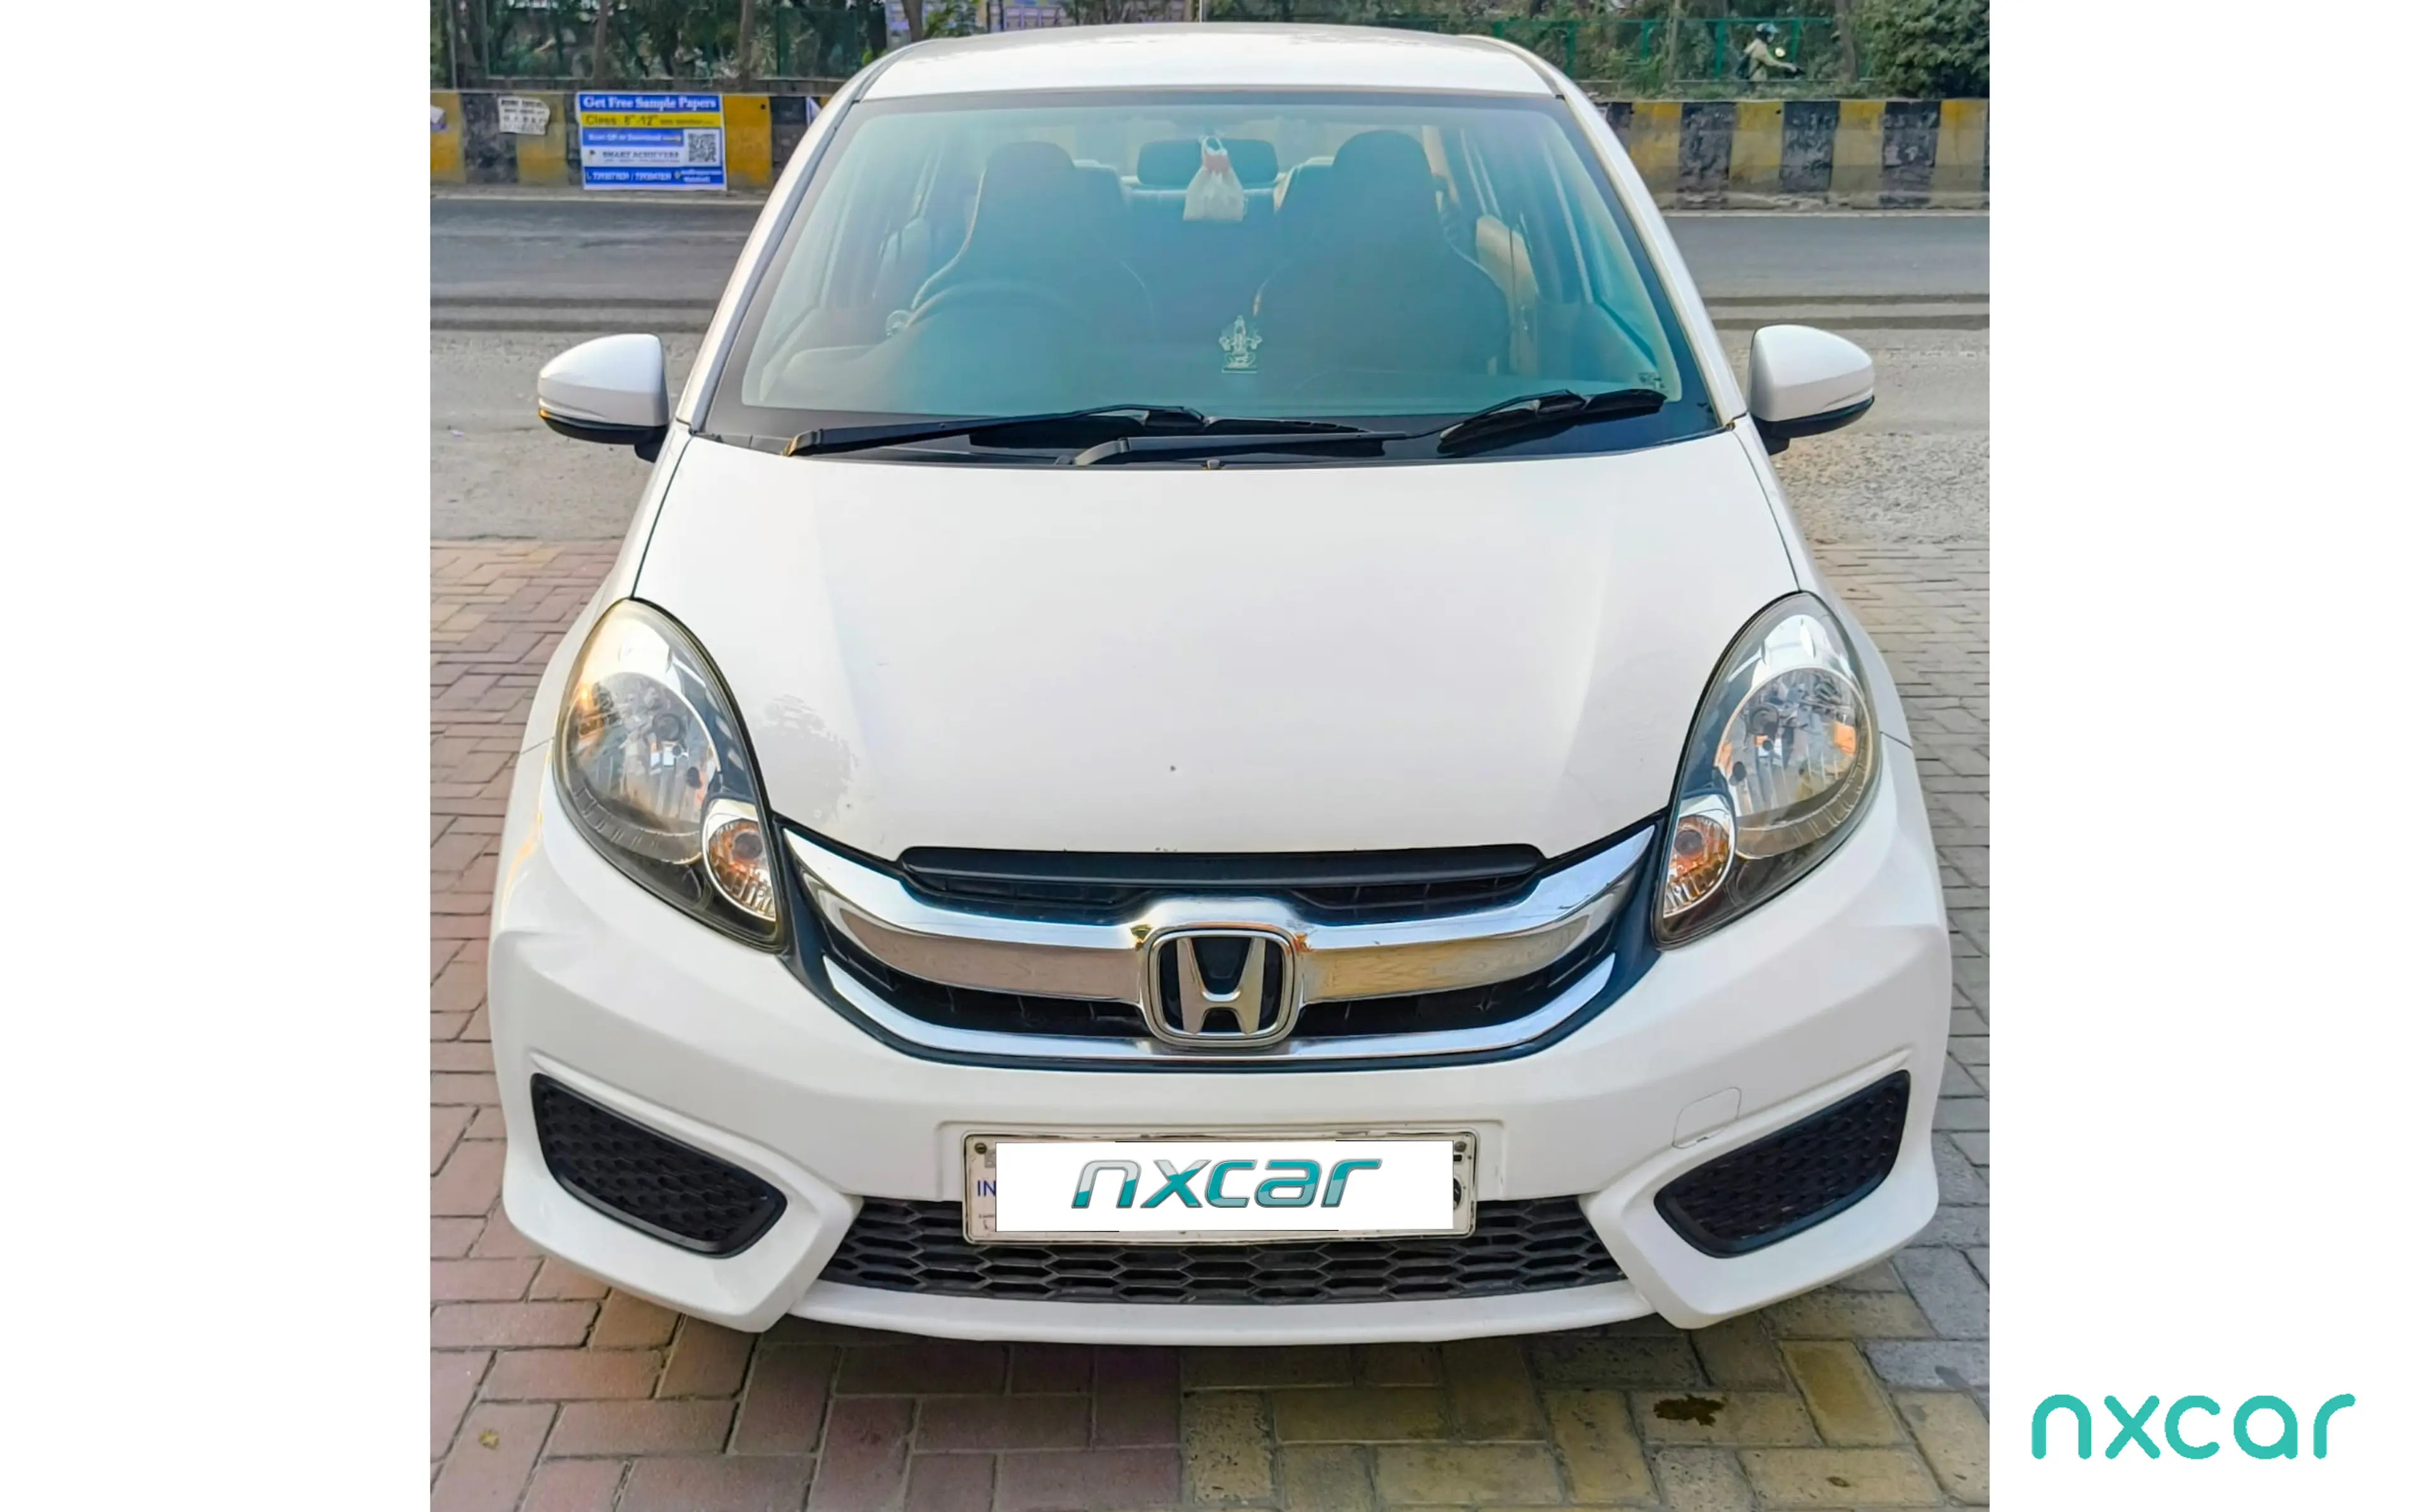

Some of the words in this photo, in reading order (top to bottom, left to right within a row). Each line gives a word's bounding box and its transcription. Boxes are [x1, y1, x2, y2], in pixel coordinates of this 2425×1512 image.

[584, 96, 606, 109] Get
[608, 96, 633, 109] Free
[635, 96, 676, 112] Sample
[678, 96, 717, 111] Papers
[978, 1180, 997, 1196] IN
